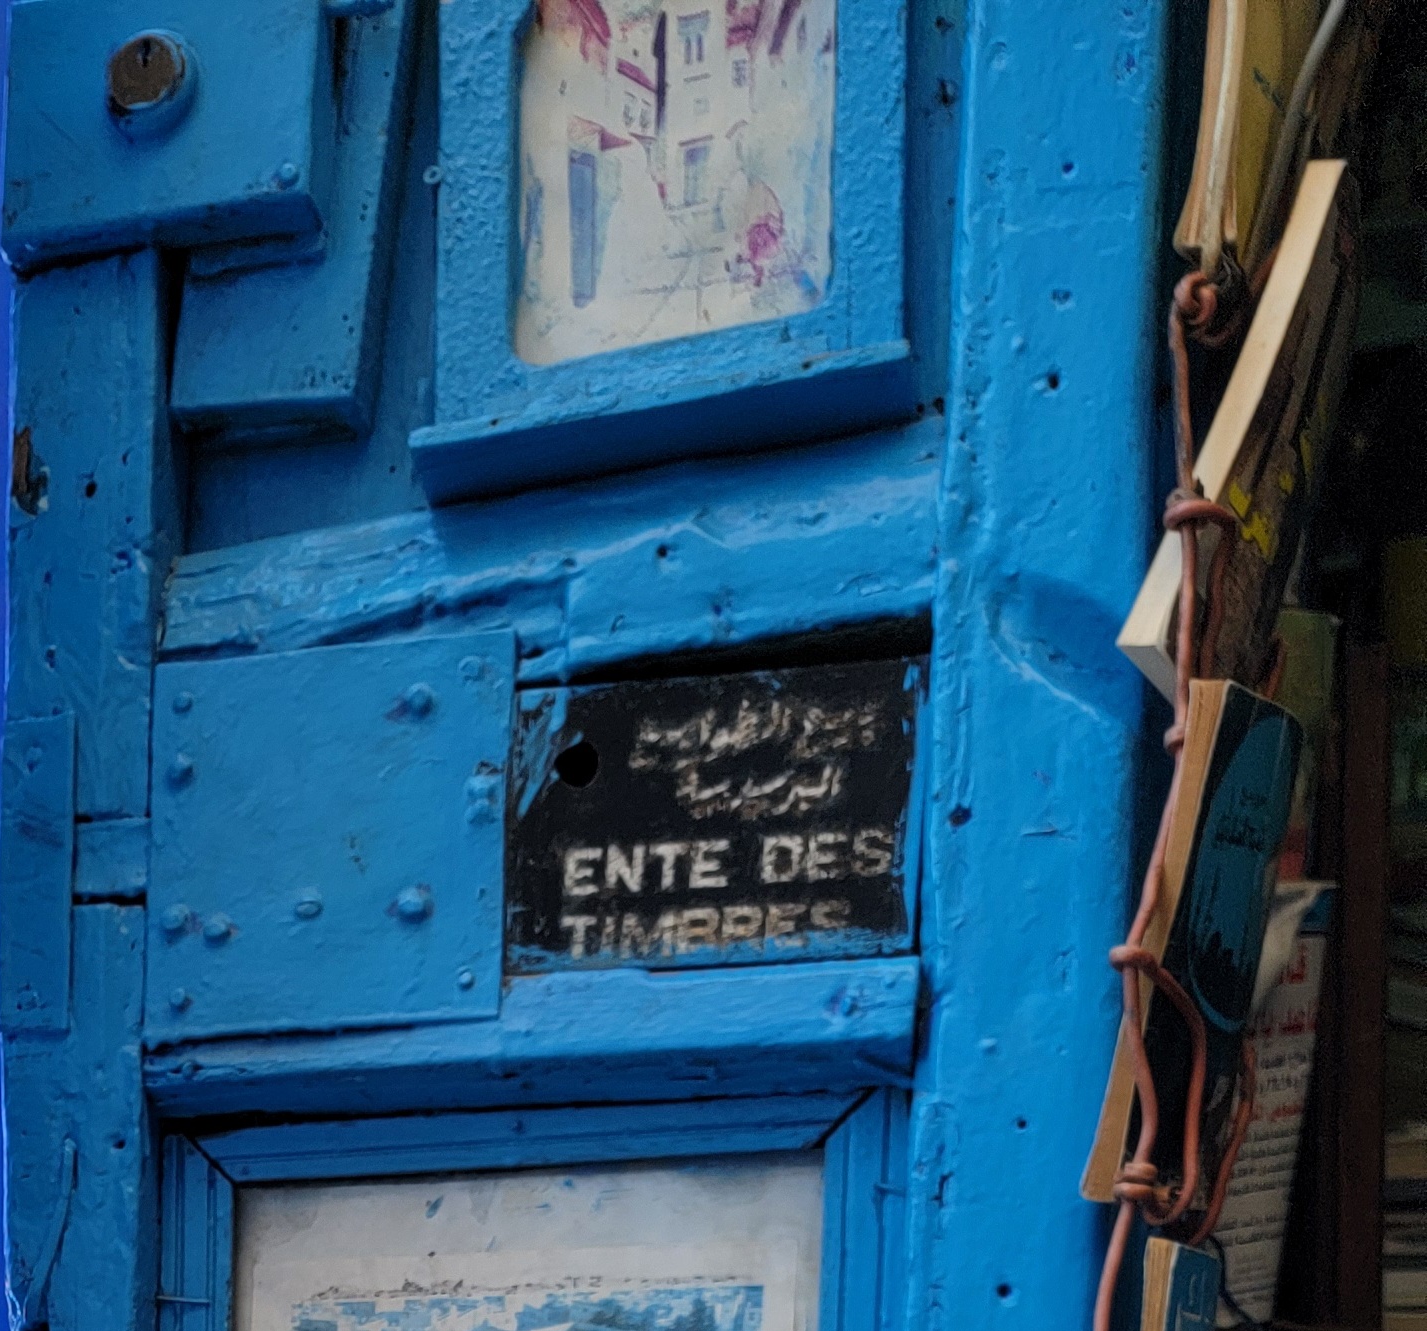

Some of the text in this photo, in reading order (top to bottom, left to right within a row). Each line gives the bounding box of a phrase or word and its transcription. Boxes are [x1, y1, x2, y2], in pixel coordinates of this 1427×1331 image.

[562, 829, 894, 897] ENTE DES
[559, 900, 853, 958] TIMBRES
